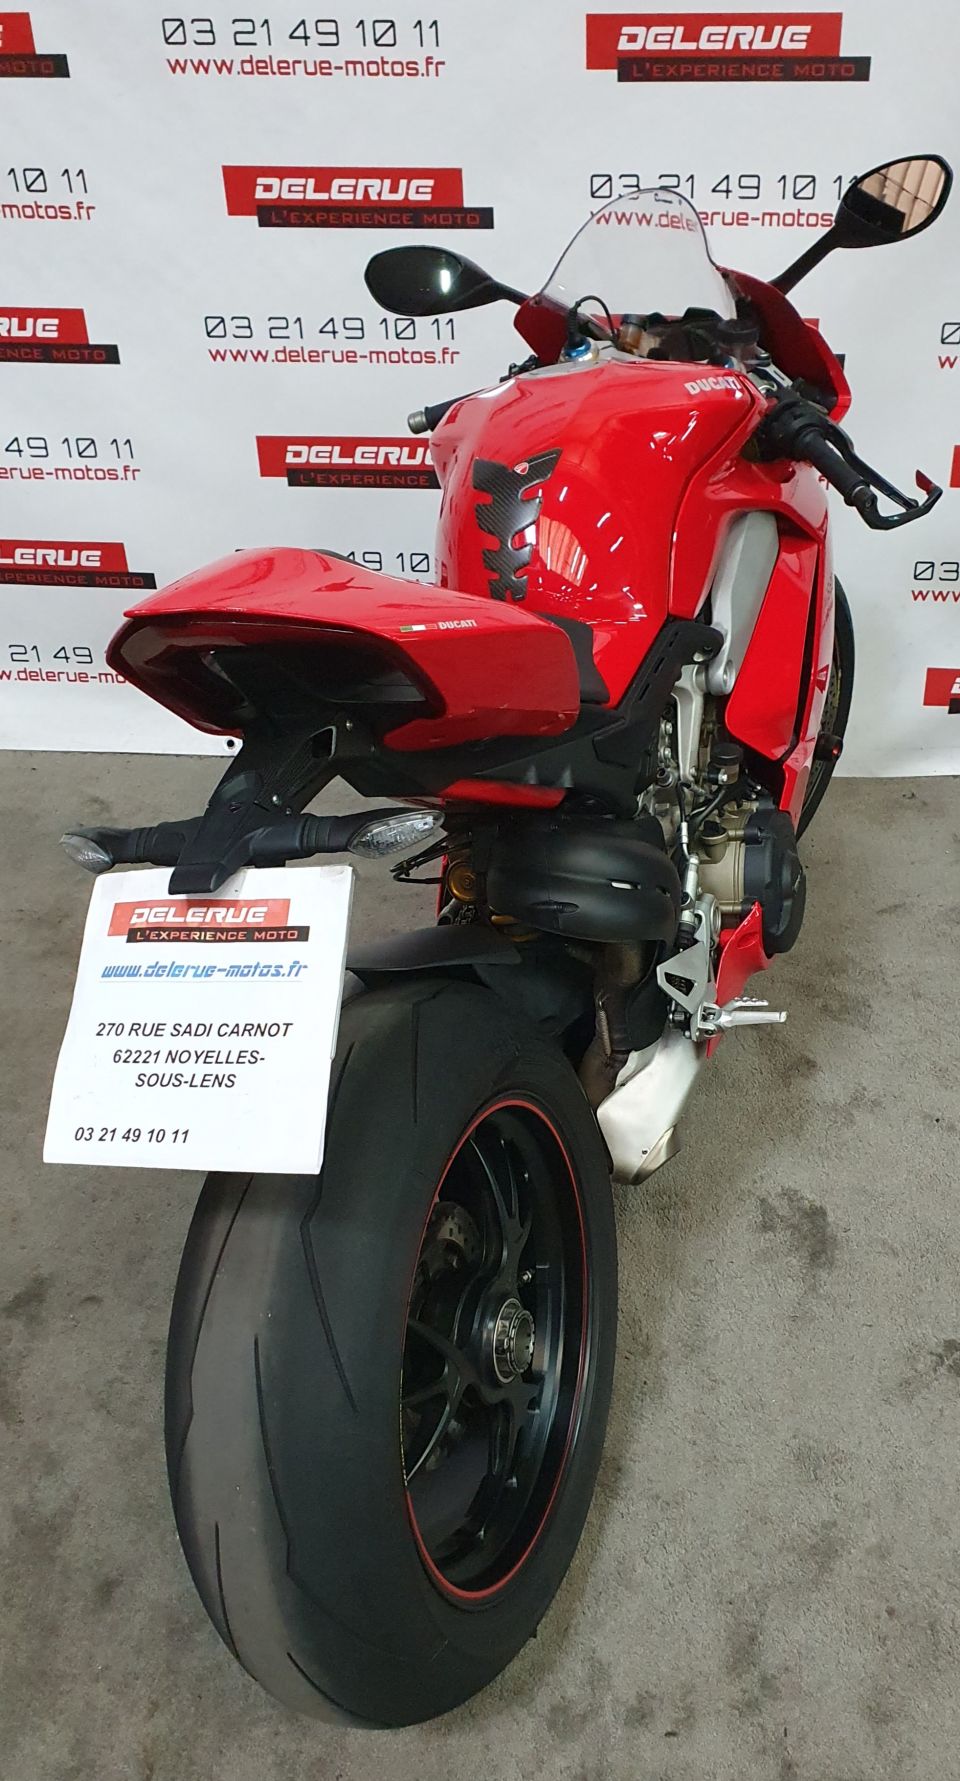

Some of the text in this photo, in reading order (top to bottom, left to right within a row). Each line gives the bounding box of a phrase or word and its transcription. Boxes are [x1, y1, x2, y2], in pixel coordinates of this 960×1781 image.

[162, 19, 439, 47] 03 21 49 10 11
[618, 26, 811, 50] DELERUE
[167, 55, 445, 77] www.delerue-motos.fr
[631, 62, 856, 77] L'EXPERIENCE MOTO
[8, 168, 87, 193] 10 11
[255, 178, 434, 200] DELERUE
[590, 174, 640, 200] 03
[654, 174, 694, 203] 21
[712, 175, 760, 199] 49
[778, 175, 816, 200] 10
[1, 201, 95, 220] motos.fr
[271, 210, 482, 227] L'EXPERIENCE MOTO
[205, 316, 455, 340] 03 21 49 10 11
[52, 350, 106, 360] MOTO
[208, 346, 460, 364] www.delerue-motos.fr
[684, 376, 741, 395] DUCATI
[5, 437, 133, 458] 49 10 11
[0, 465, 140, 480] erue-motos.fr
[300, 473, 430, 486] L'EXPERIENCE
[396, 553, 429, 572] 10
[0, 572, 144, 586] PERIENCE MOTO
[437, 619, 477, 630] DUCATI
[9, 645, 93, 664] 21 49
[130, 907, 268, 924] DELERUE
[136, 930, 298, 941] L'EXPERIENCE MOTO
[101, 961, 307, 978] www.delerue-motos.fr
[95, 1022, 294, 1038] 270 RUE SADI CARNOT
[113, 1049, 265, 1065] 62221 NOYELLES-
[135, 1073, 237, 1088] SOUS-LENS
[74, 1127, 189, 1144] 03 21 49 10 11
